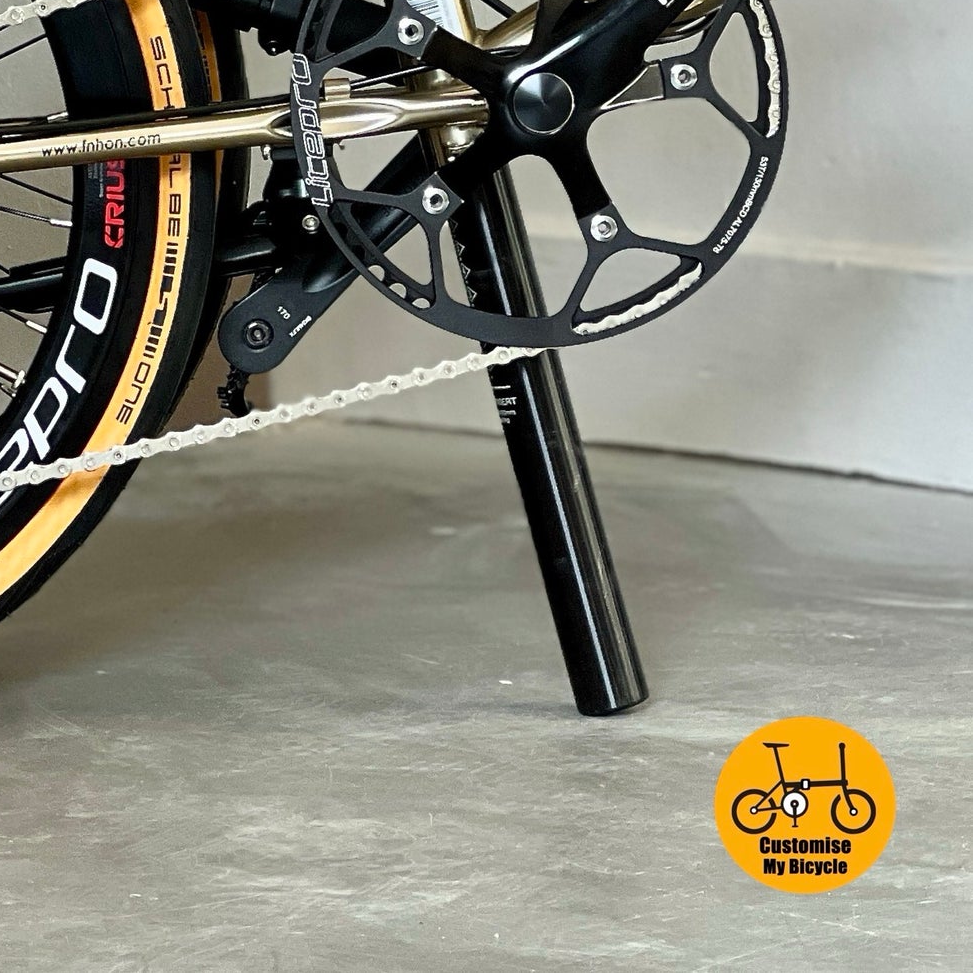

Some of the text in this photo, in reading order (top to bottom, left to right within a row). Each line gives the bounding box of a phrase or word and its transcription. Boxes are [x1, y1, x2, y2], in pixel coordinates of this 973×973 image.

[42, 133, 161, 157] www.fnhon.com
[277, 306, 291, 320] 170
[116, 362, 151, 425] ONE
